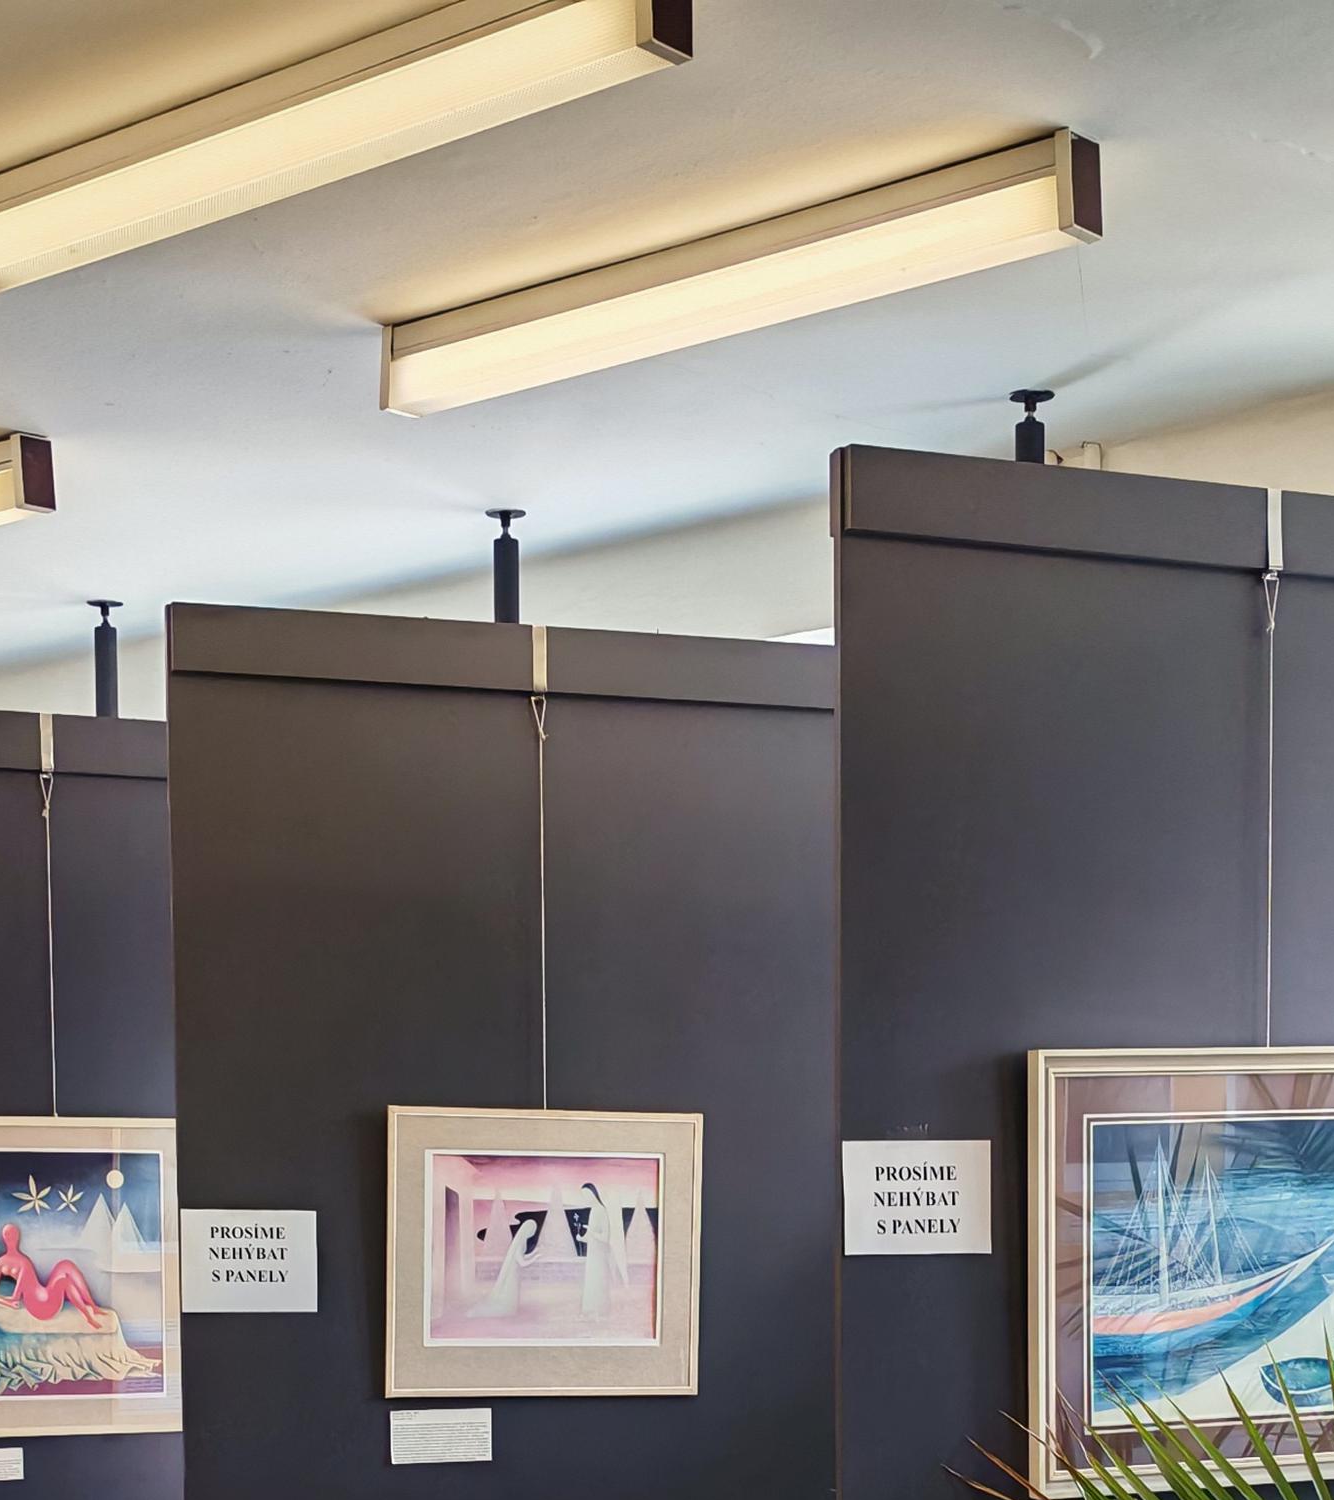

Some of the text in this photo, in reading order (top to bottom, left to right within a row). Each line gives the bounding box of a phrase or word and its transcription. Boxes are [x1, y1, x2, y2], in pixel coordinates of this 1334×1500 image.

[875, 1161, 957, 1181] PROSÍME
[873, 1187, 959, 1207] NEHÝBAT
[210, 1223, 285, 1239] PROSÍME
[876, 1218, 960, 1235] S PANELY
[209, 1243, 288, 1260] NEHÝBAT
[211, 1269, 289, 1282] S PANELY
